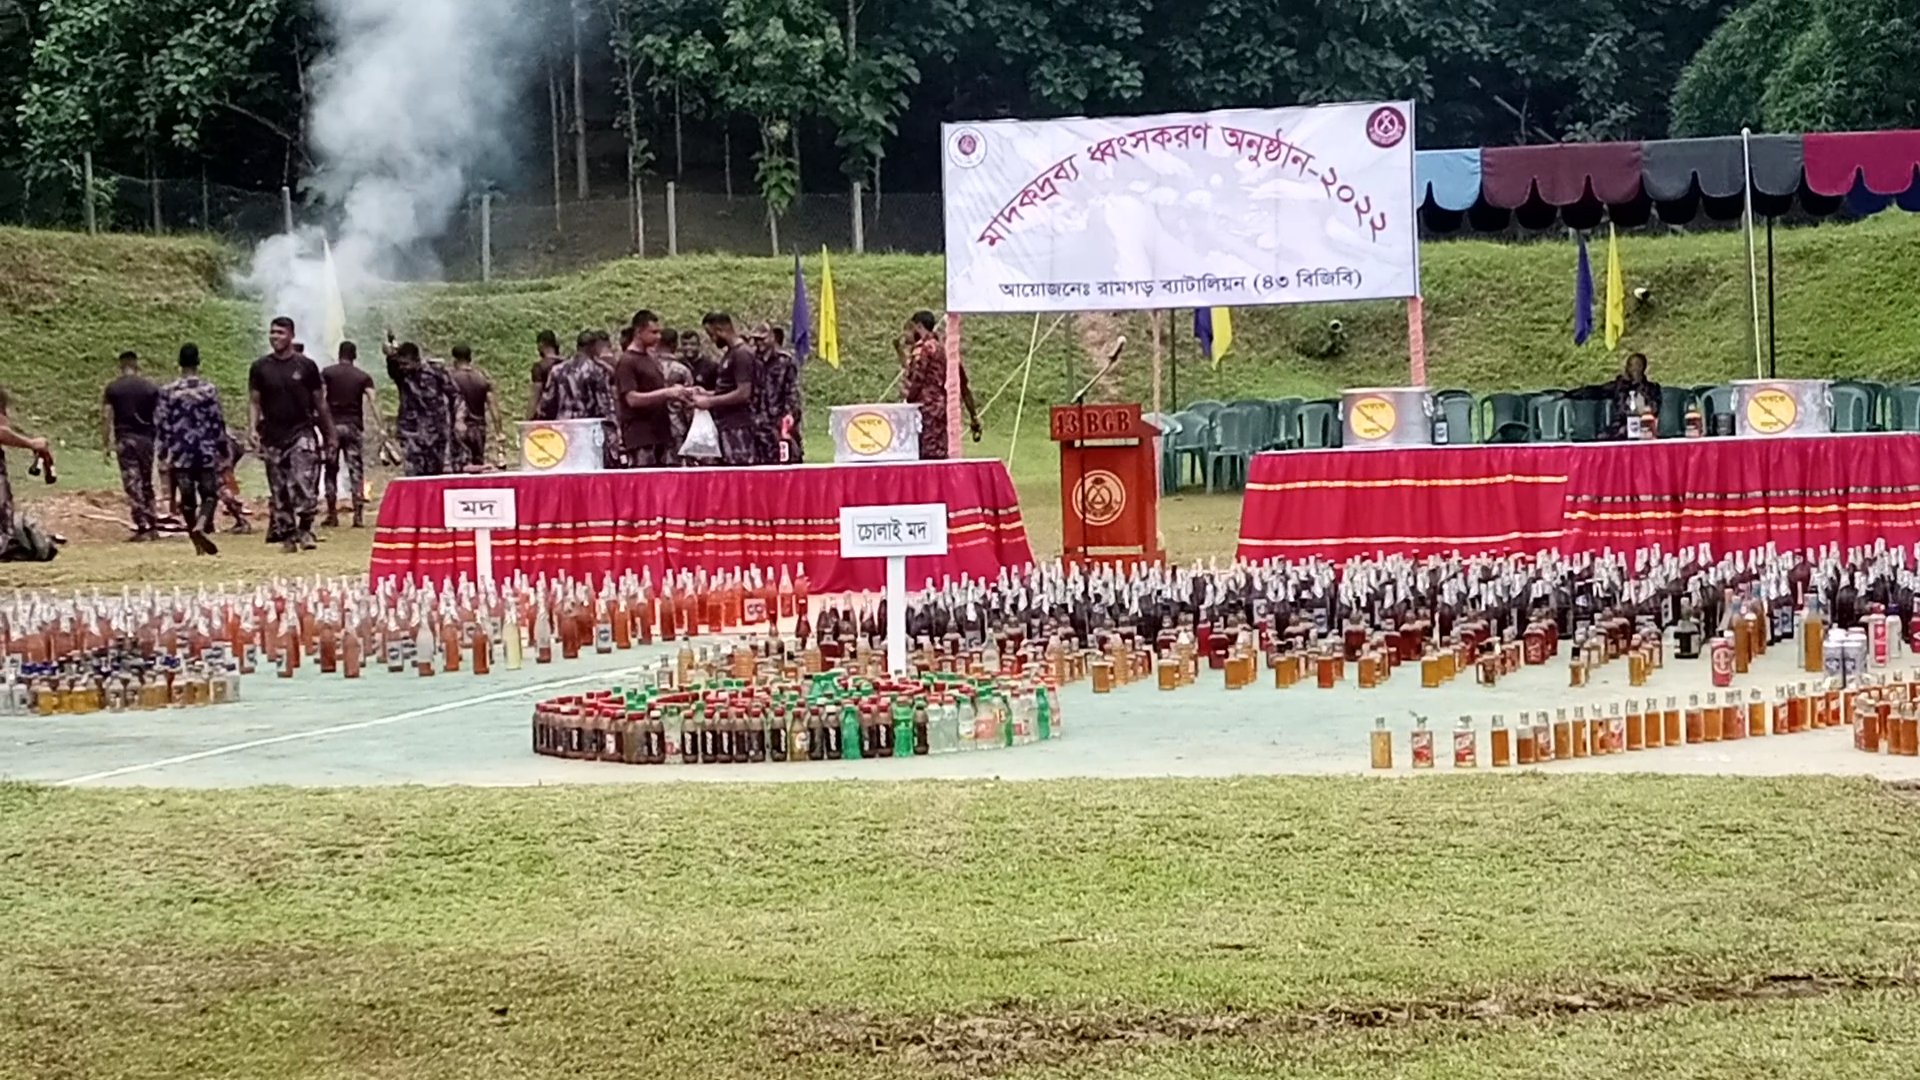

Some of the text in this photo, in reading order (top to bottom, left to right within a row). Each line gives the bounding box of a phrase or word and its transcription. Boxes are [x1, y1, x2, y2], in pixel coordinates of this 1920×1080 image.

[976, 122, 1387, 246] মাদকদ্রব্য ধ্বংসকরণ অনুষ্ঠান-২০২২
[1097, 281, 1155, 297] রামগড়
[1160, 273, 1246, 294] ব্যাটালিয়ন
[1253, 273, 1290, 294] (৪৩
[1295, 266, 1362, 289] বিজিবি)
[1085, 409, 1131, 434] BGB
[458, 500, 498, 515] মদ
[857, 517, 927, 541] চোলাই মদ
